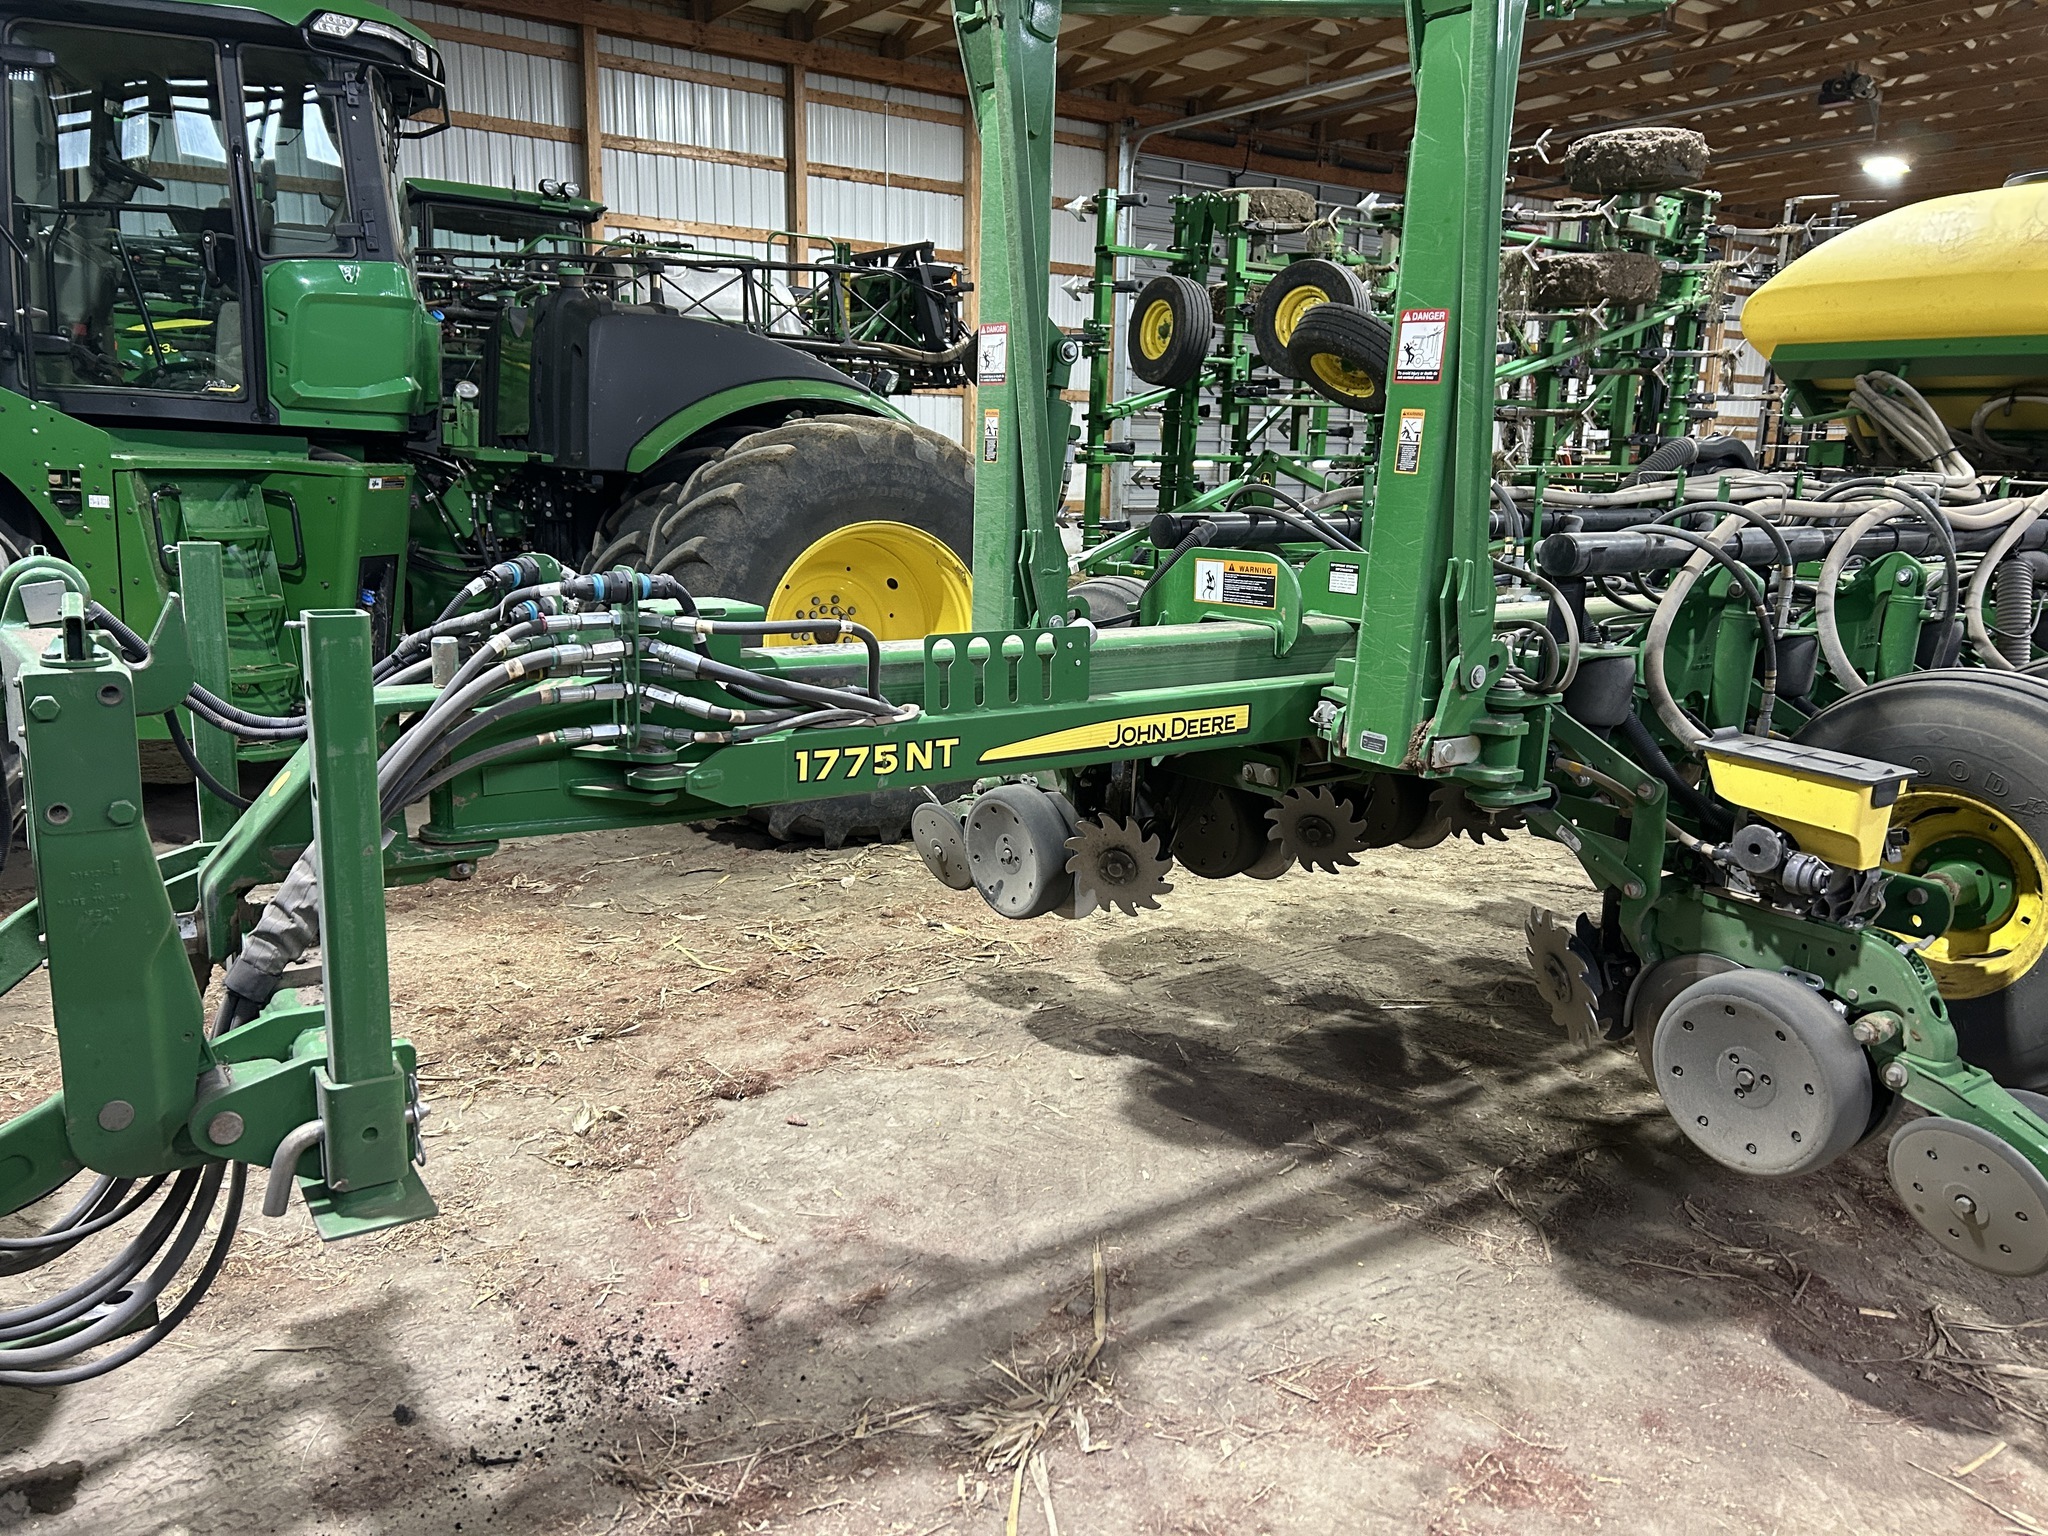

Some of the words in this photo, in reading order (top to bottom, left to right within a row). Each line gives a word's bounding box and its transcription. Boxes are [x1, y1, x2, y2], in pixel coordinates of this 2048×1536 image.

[1412, 311, 1445, 320] DANGER
[986, 324, 1006, 333] DANGER
[1239, 565, 1272, 575] WARNING
[1109, 723, 1166, 746] JOHN
[1171, 714, 1237, 738] DEERE
